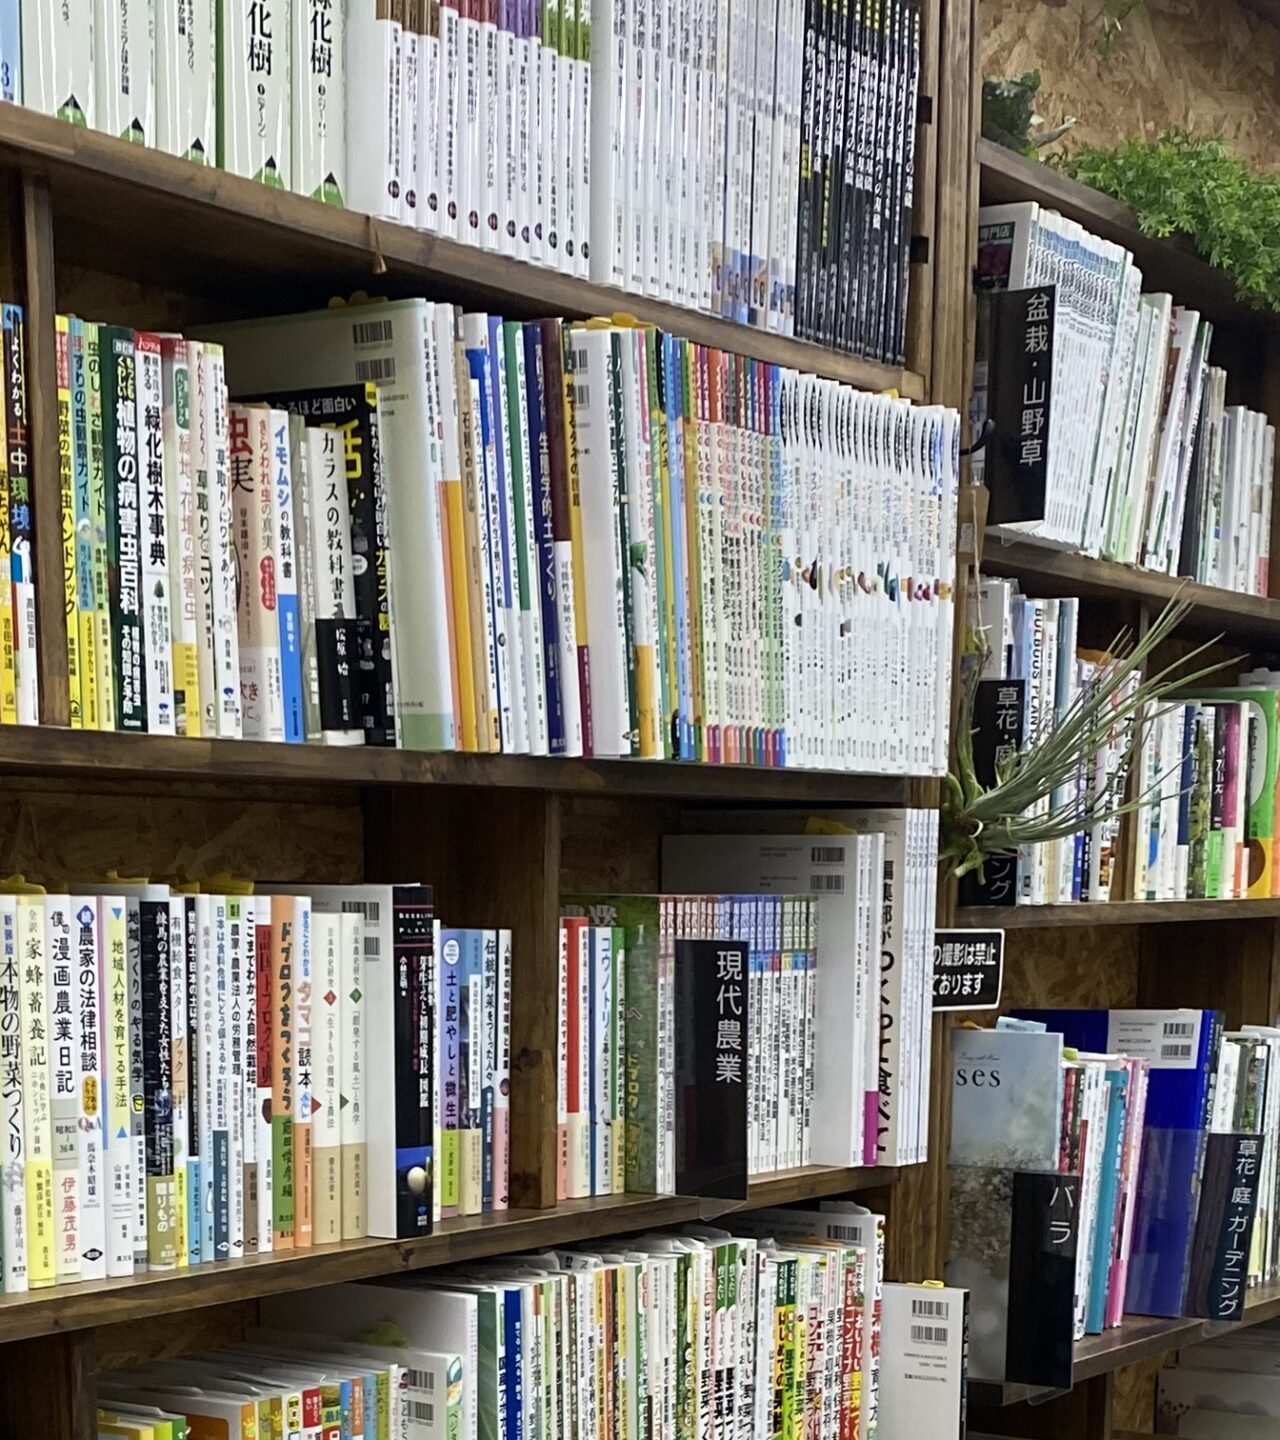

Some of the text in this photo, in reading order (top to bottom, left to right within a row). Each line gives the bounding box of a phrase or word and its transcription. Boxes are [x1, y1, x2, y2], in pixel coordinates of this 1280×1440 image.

[0, 62, 11, 87] 3
[1019, 294, 1050, 465] 盆栽・山野草
[145, 407, 166, 567] 緑化樹木事典
[274, 424, 292, 579] イモムシの教科書
[321, 433, 345, 600] カラスの教科書
[79, 926, 98, 1072] 農家の法律相談
[112, 941, 127, 1107] 地域人材を育てる手法
[715, 950, 743, 1084] 現代農業
[1049, 1186, 1076, 1244] バラ
[1219, 1140, 1259, 1316] 草花・庭・ガーデニング
